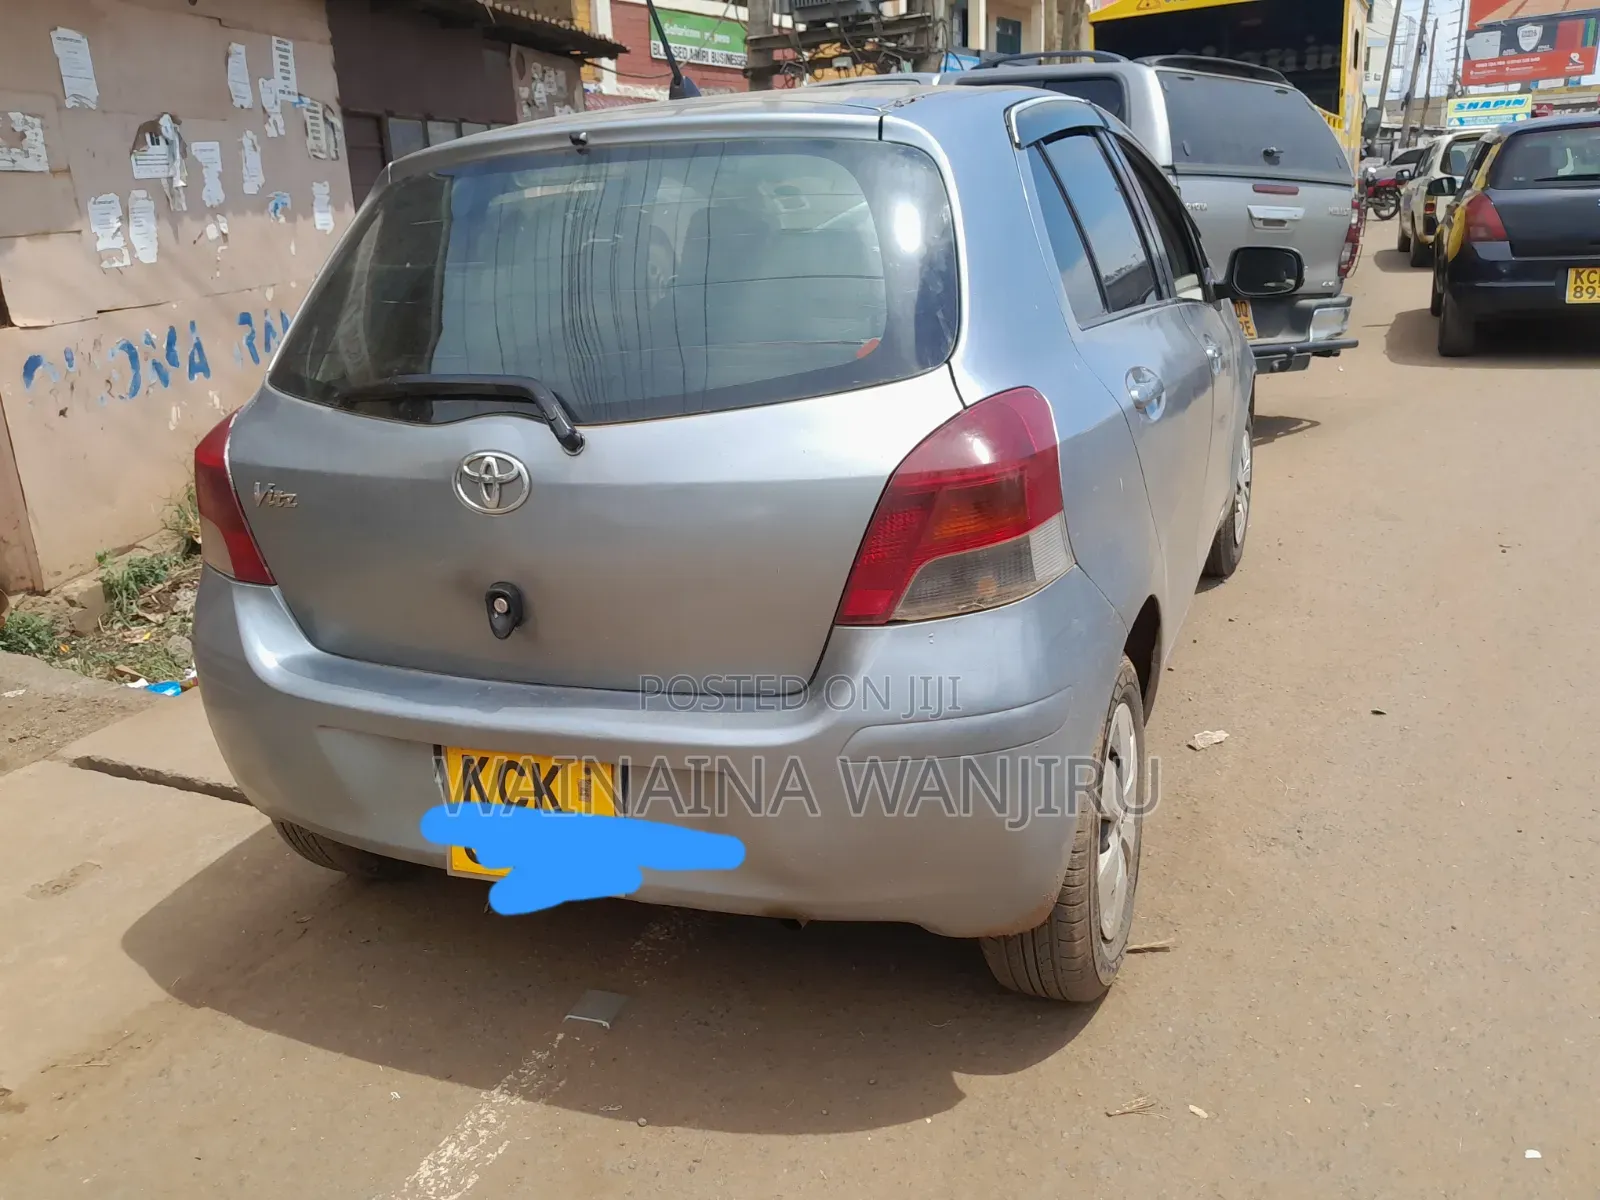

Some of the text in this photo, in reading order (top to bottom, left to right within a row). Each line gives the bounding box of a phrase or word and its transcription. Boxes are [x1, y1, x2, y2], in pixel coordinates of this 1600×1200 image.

[1573, 269, 1600, 285] KC
[253, 481, 298, 508] Vitz
[461, 754, 564, 812] KCK
